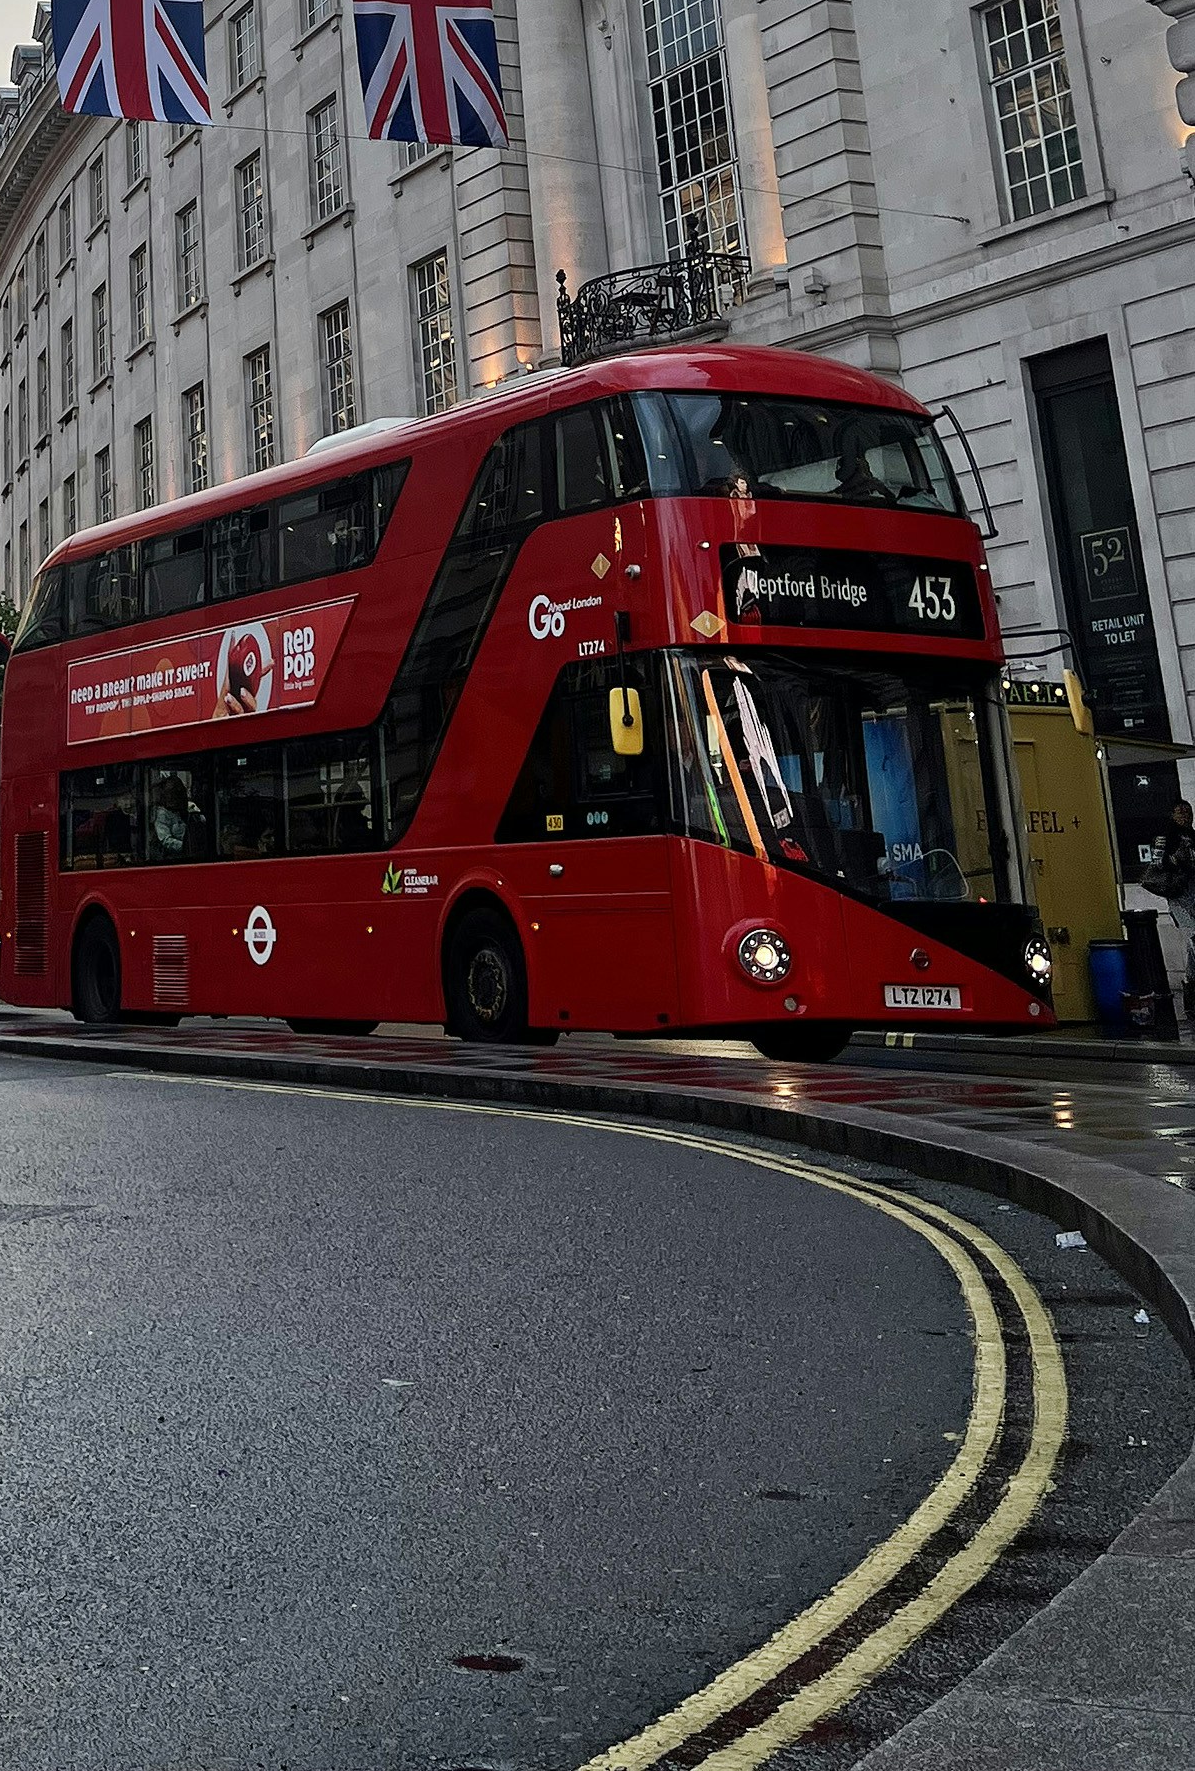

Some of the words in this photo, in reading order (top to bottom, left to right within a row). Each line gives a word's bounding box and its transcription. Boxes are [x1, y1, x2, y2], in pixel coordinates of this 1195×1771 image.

[1091, 537, 1125, 577] 52
[820, 575, 868, 607] Bridge
[908, 576, 956, 621] 453
[528, 594, 565, 640] Go
[1091, 618, 1123, 632] RETAIL
[1123, 613, 1146, 627] UNIT
[578, 639, 605, 657] LT274
[1104, 632, 1118, 645] TO
[1119, 629, 1136, 644] LET
[283, 651, 315, 681] POP
